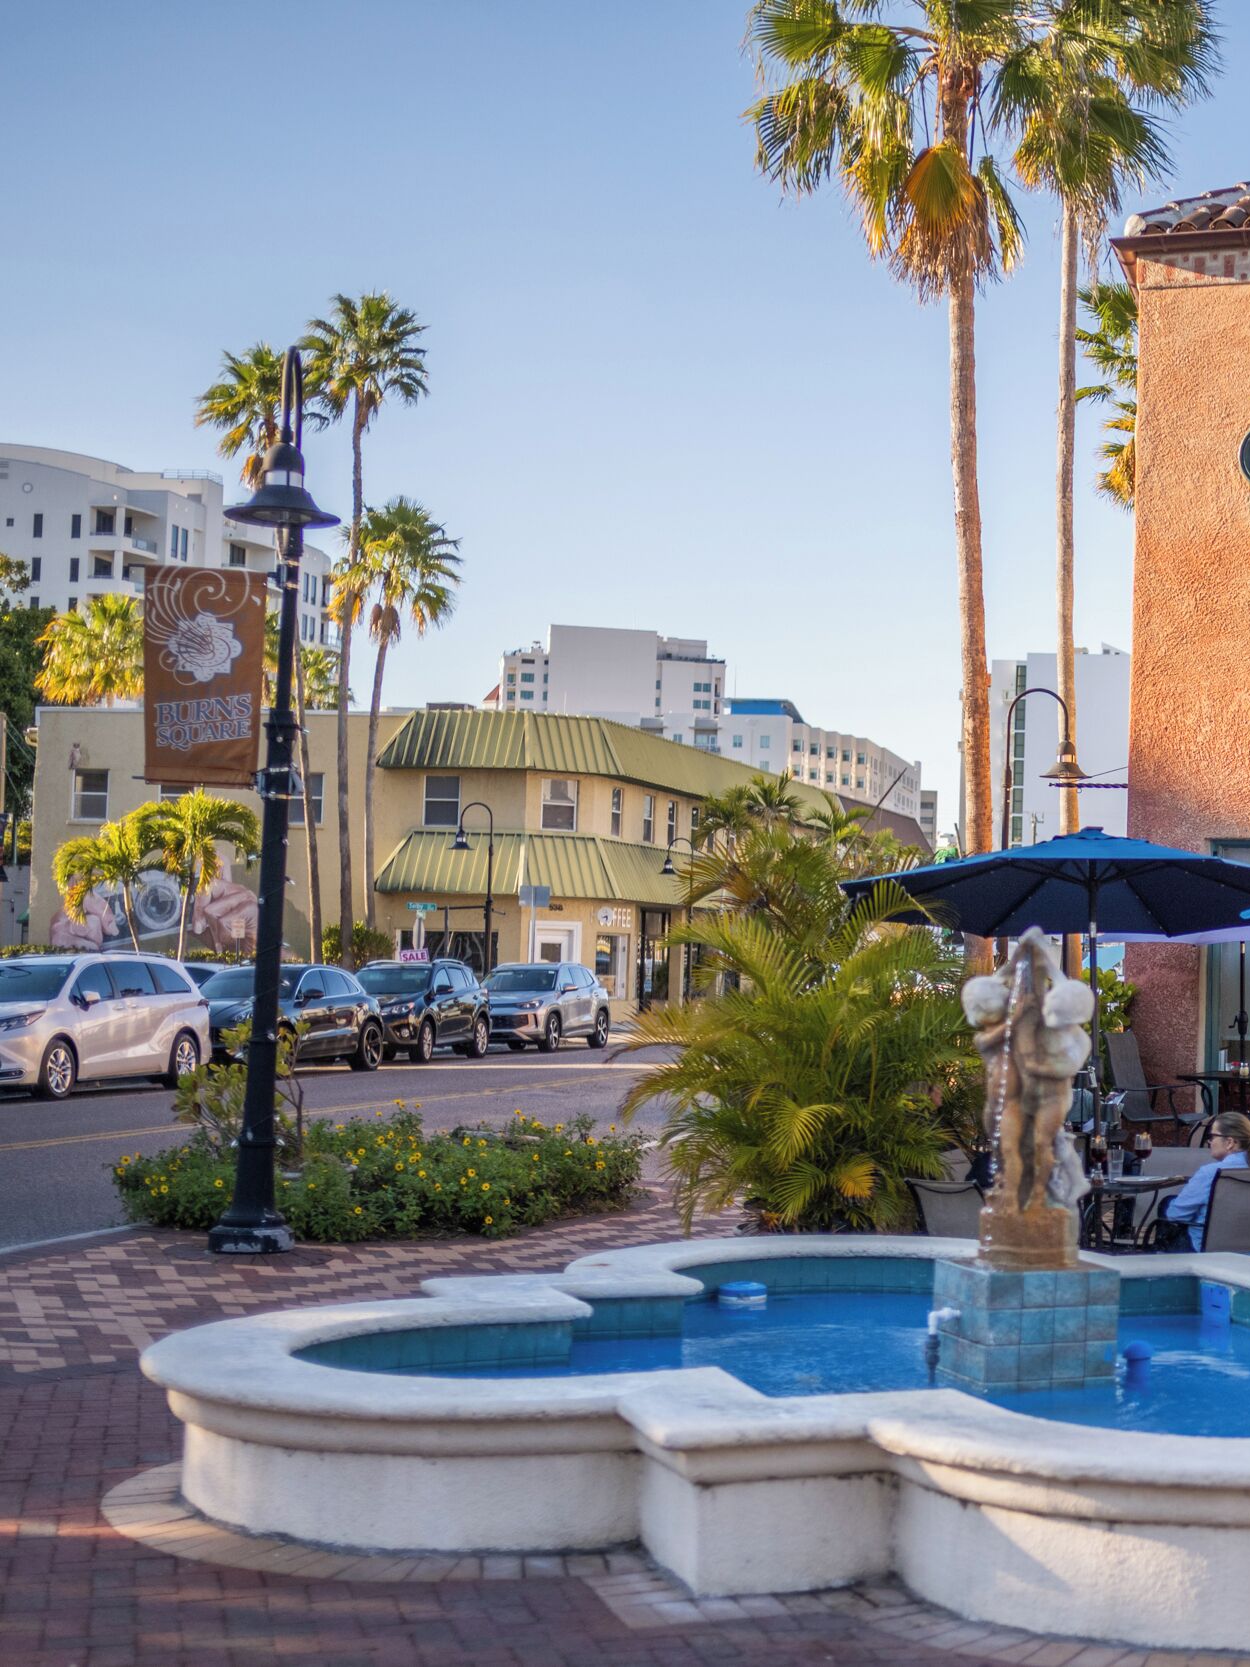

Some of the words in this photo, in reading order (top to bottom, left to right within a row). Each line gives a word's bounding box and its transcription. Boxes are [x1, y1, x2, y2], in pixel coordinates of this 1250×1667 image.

[154, 693, 253, 727] BURNS
[156, 719, 252, 751] SQUARE
[402, 951, 427, 961] SALE
